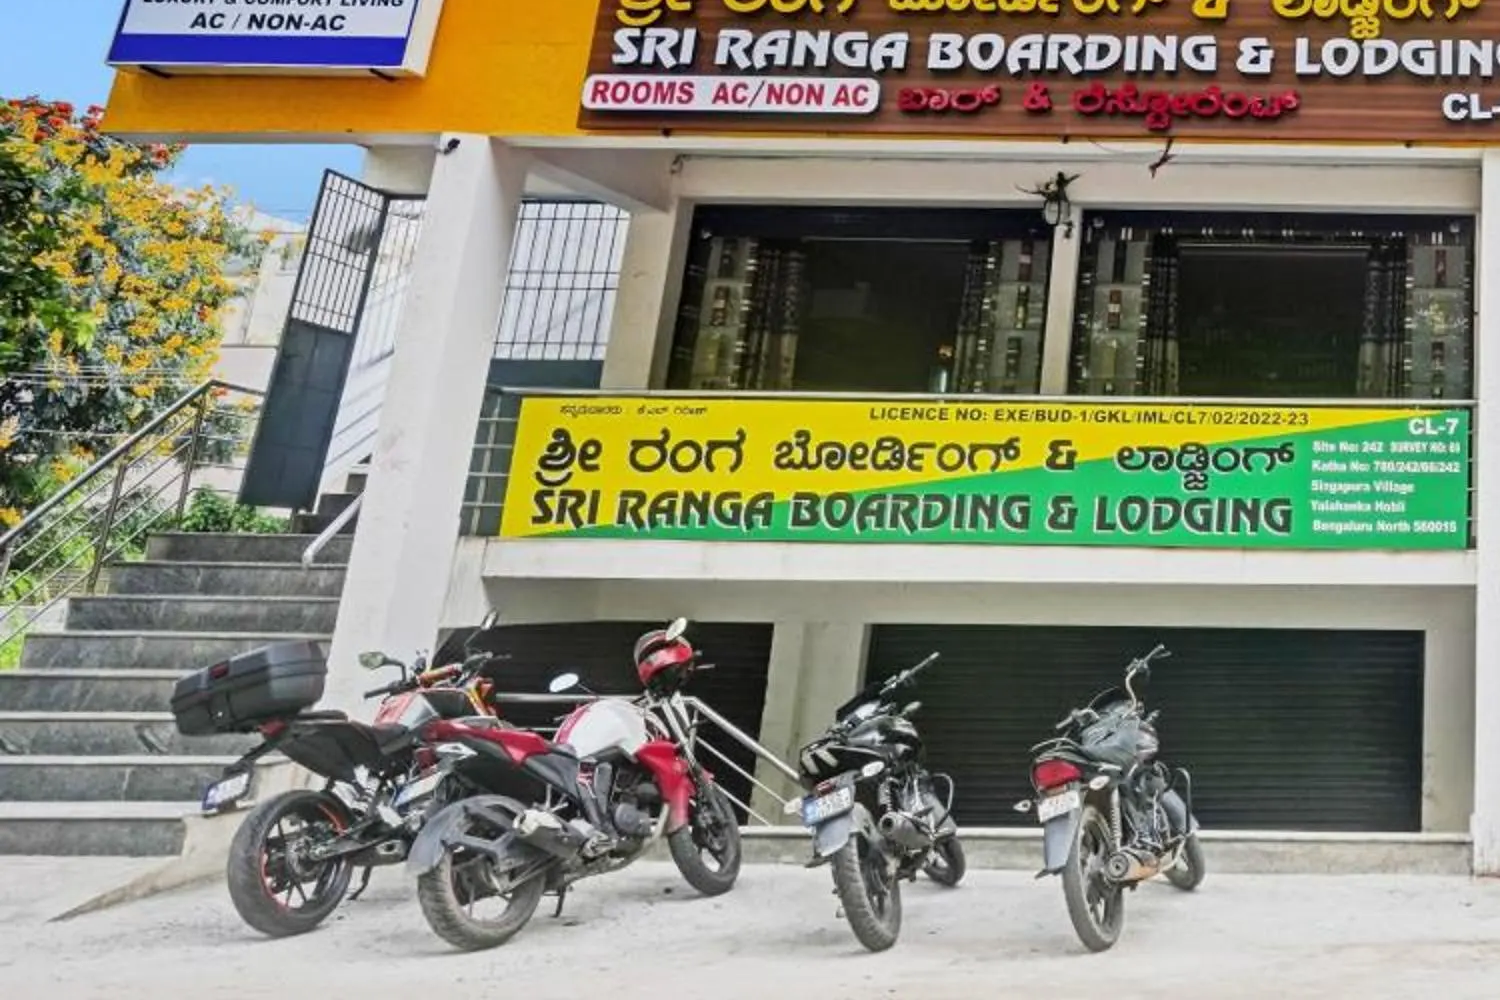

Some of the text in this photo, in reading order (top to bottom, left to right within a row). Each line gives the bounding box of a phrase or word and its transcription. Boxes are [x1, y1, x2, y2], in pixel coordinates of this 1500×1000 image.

[190, 13, 225, 30] AC
[247, 13, 347, 31] NON-AC
[612, 27, 697, 69] SRI
[714, 29, 908, 72] RANGA
[927, 33, 1217, 75] BOARDING
[1236, 37, 1274, 74] &
[591, 80, 869, 107] ROOMS AC/NON AC
[1023, 80, 1051, 112] &
[869, 407, 949, 421] LICENCE
[956, 408, 988, 422] NO:
[1408, 418, 1459, 435] CL-7
[535, 427, 603, 487] ಶ್ರೀ
[628, 427, 747, 473] ರಂಗ
[1044, 439, 1079, 471] &
[1311, 480, 1415, 494] Singapura Village
[530, 489, 1293, 536] SRI RANGA BOARDING & LODGING
[1375, 500, 1405, 513] Hobli
[1313, 520, 1372, 534] Bengaluru
[1376, 520, 1410, 532] North
